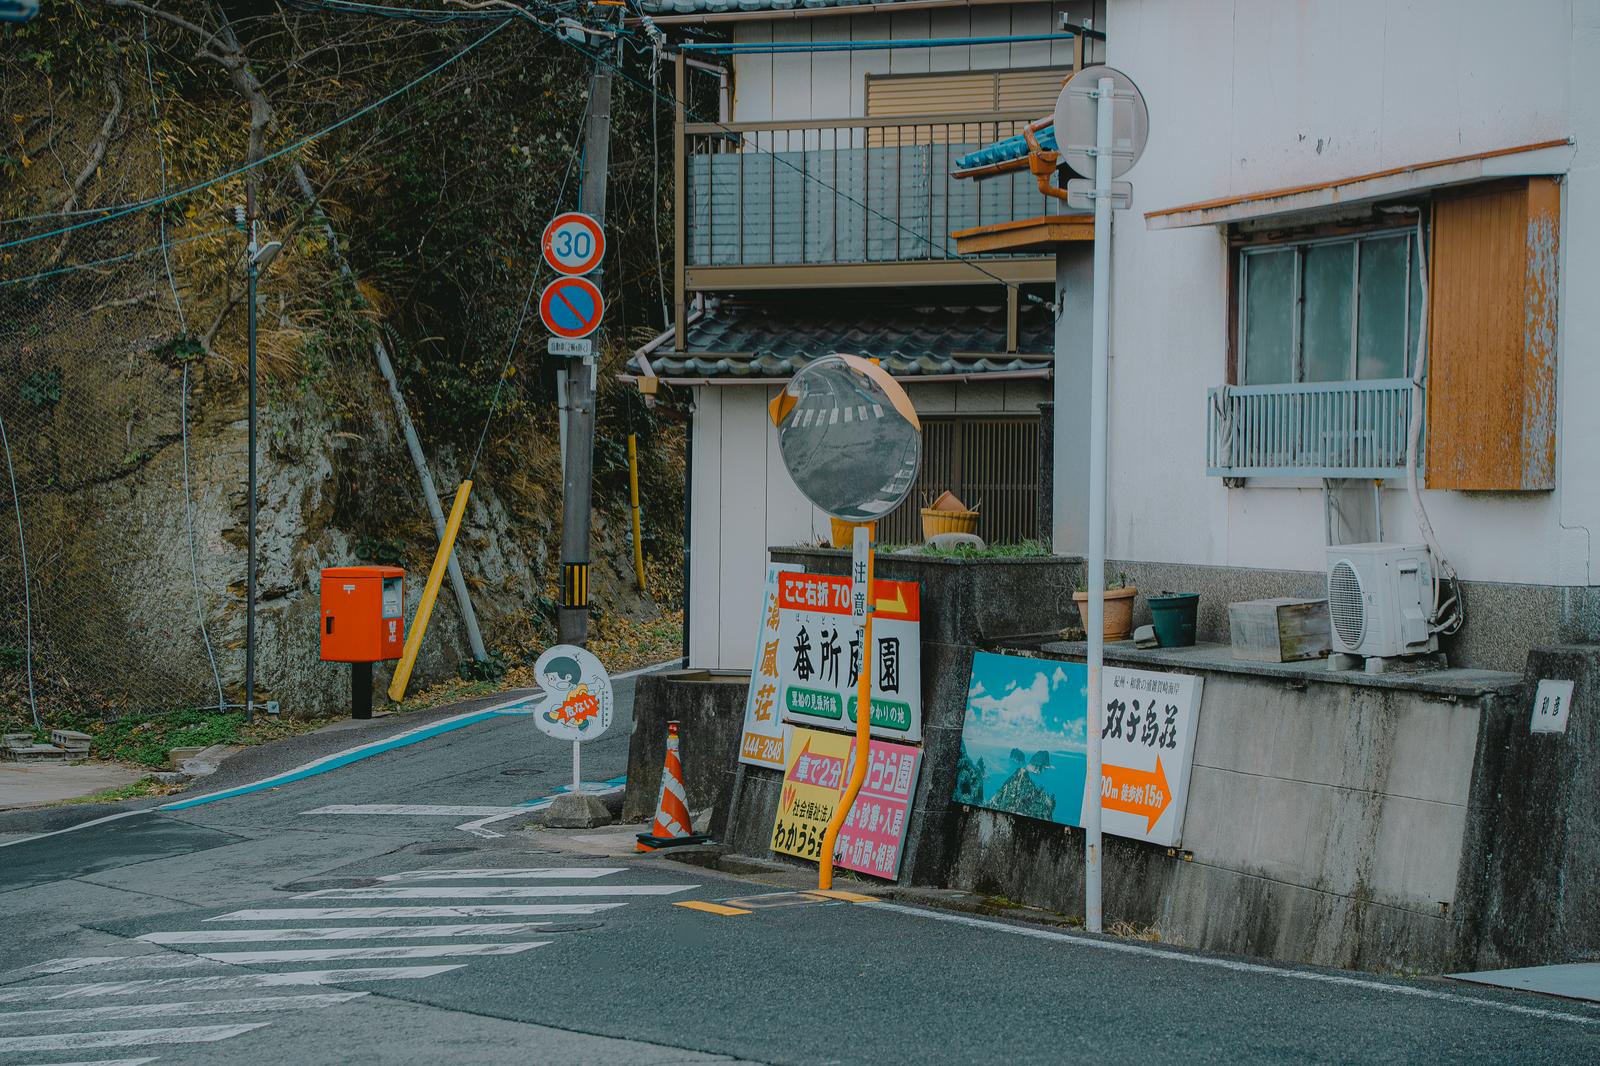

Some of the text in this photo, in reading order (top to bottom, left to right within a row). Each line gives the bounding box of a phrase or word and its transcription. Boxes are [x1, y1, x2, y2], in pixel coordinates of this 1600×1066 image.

[556, 231, 590, 258] 30
[785, 579, 852, 608] ここ右折 70
[854, 560, 868, 618] 注意
[564, 698, 595, 718] 危ない
[742, 737, 784, 760] 444-2848
[796, 754, 842, 788] 車で2分
[792, 798, 834, 823] 社会福祉法人
